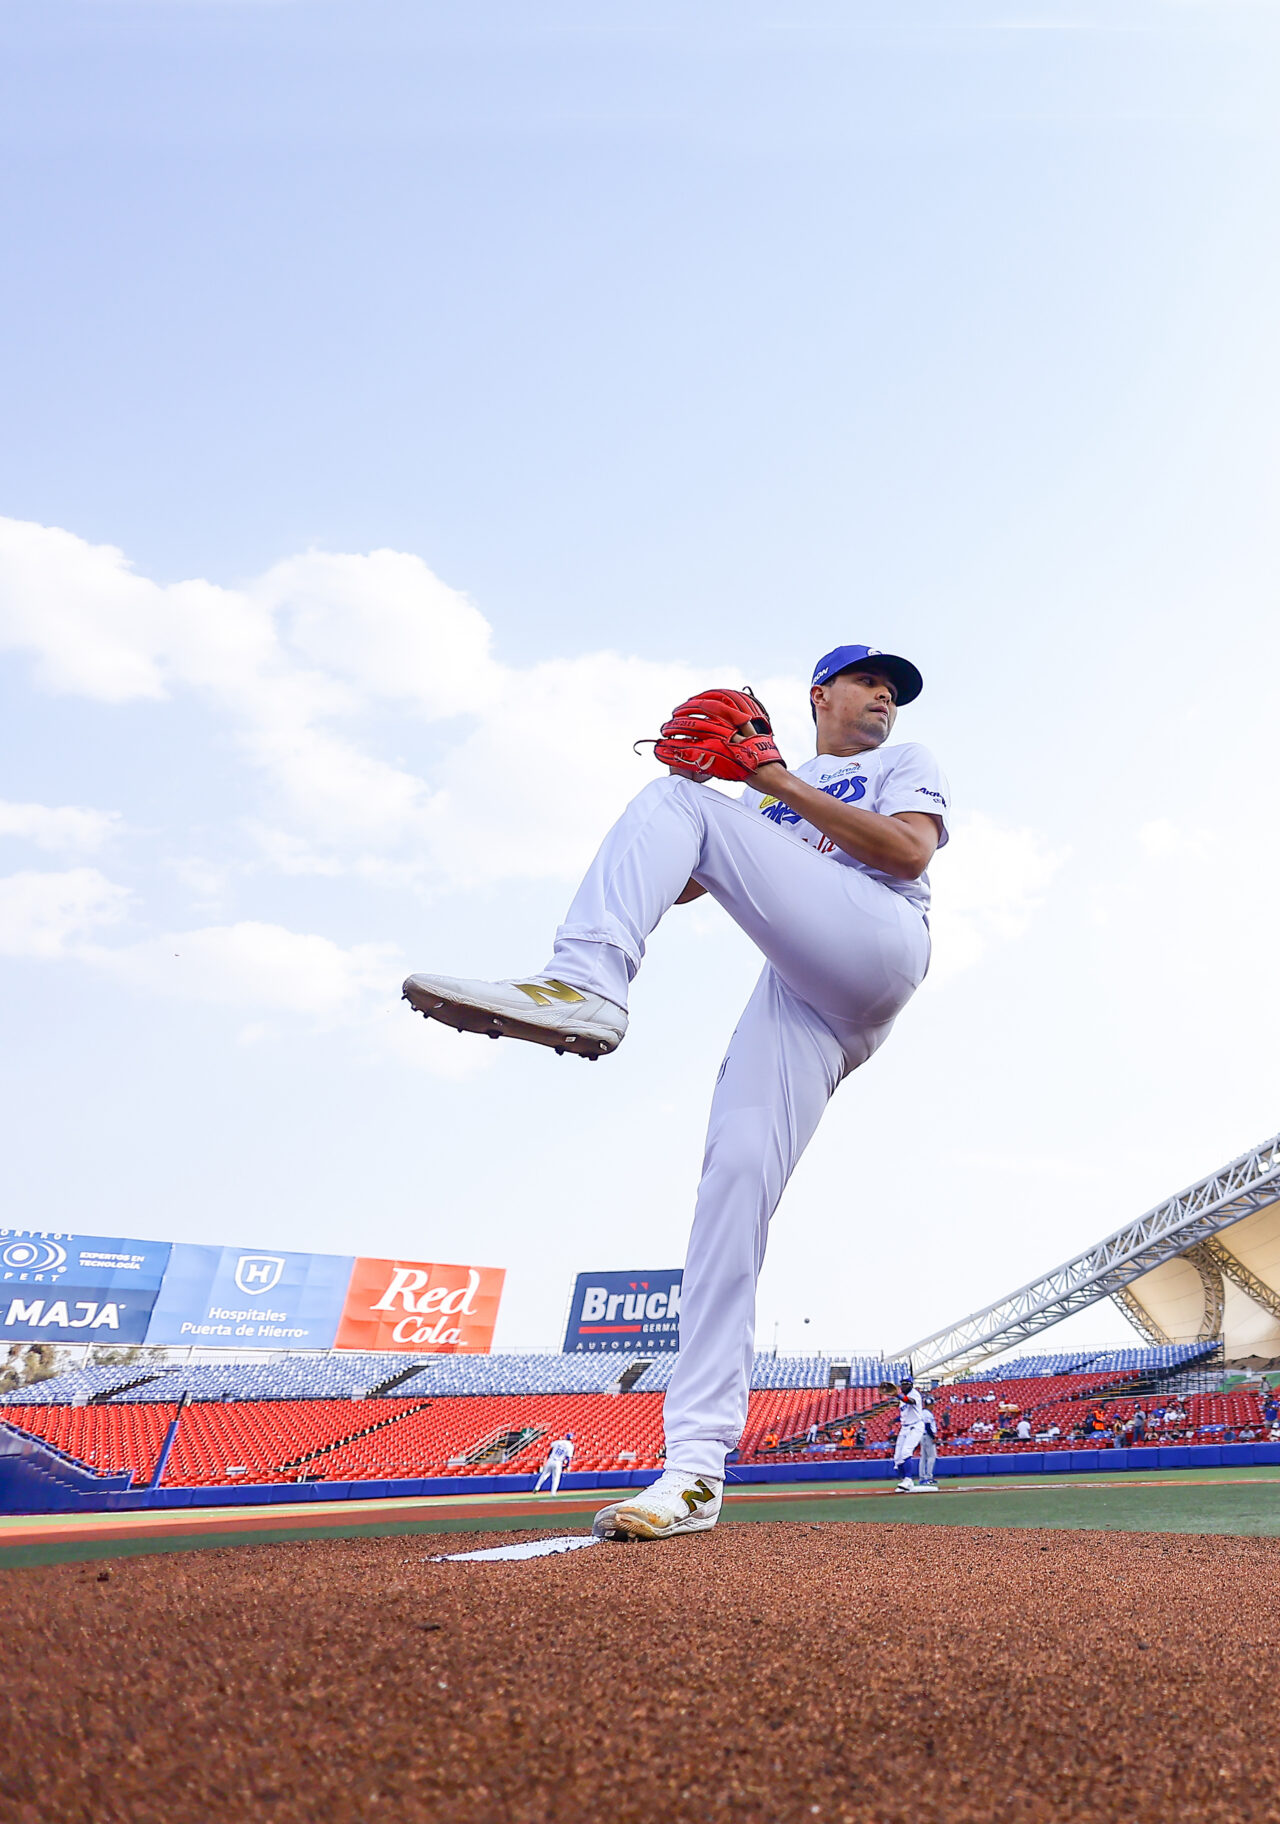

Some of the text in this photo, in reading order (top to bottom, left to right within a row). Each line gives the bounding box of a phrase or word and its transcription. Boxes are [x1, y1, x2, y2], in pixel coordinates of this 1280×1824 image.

[0, 1229, 74, 1241] ONTROL
[3, 1271, 61, 1283] PERT
[370, 1267, 480, 1316] Red
[580, 1282, 681, 1322] Brück
[4, 1298, 120, 1330] MAJA
[208, 1307, 287, 1322] Hospitales
[180, 1322, 304, 1338] Puerta de Hierro
[392, 1315, 463, 1345] Cola
[642, 1323, 680, 1333] GERMA
[576, 1338, 677, 1350] AUTOPARTE
